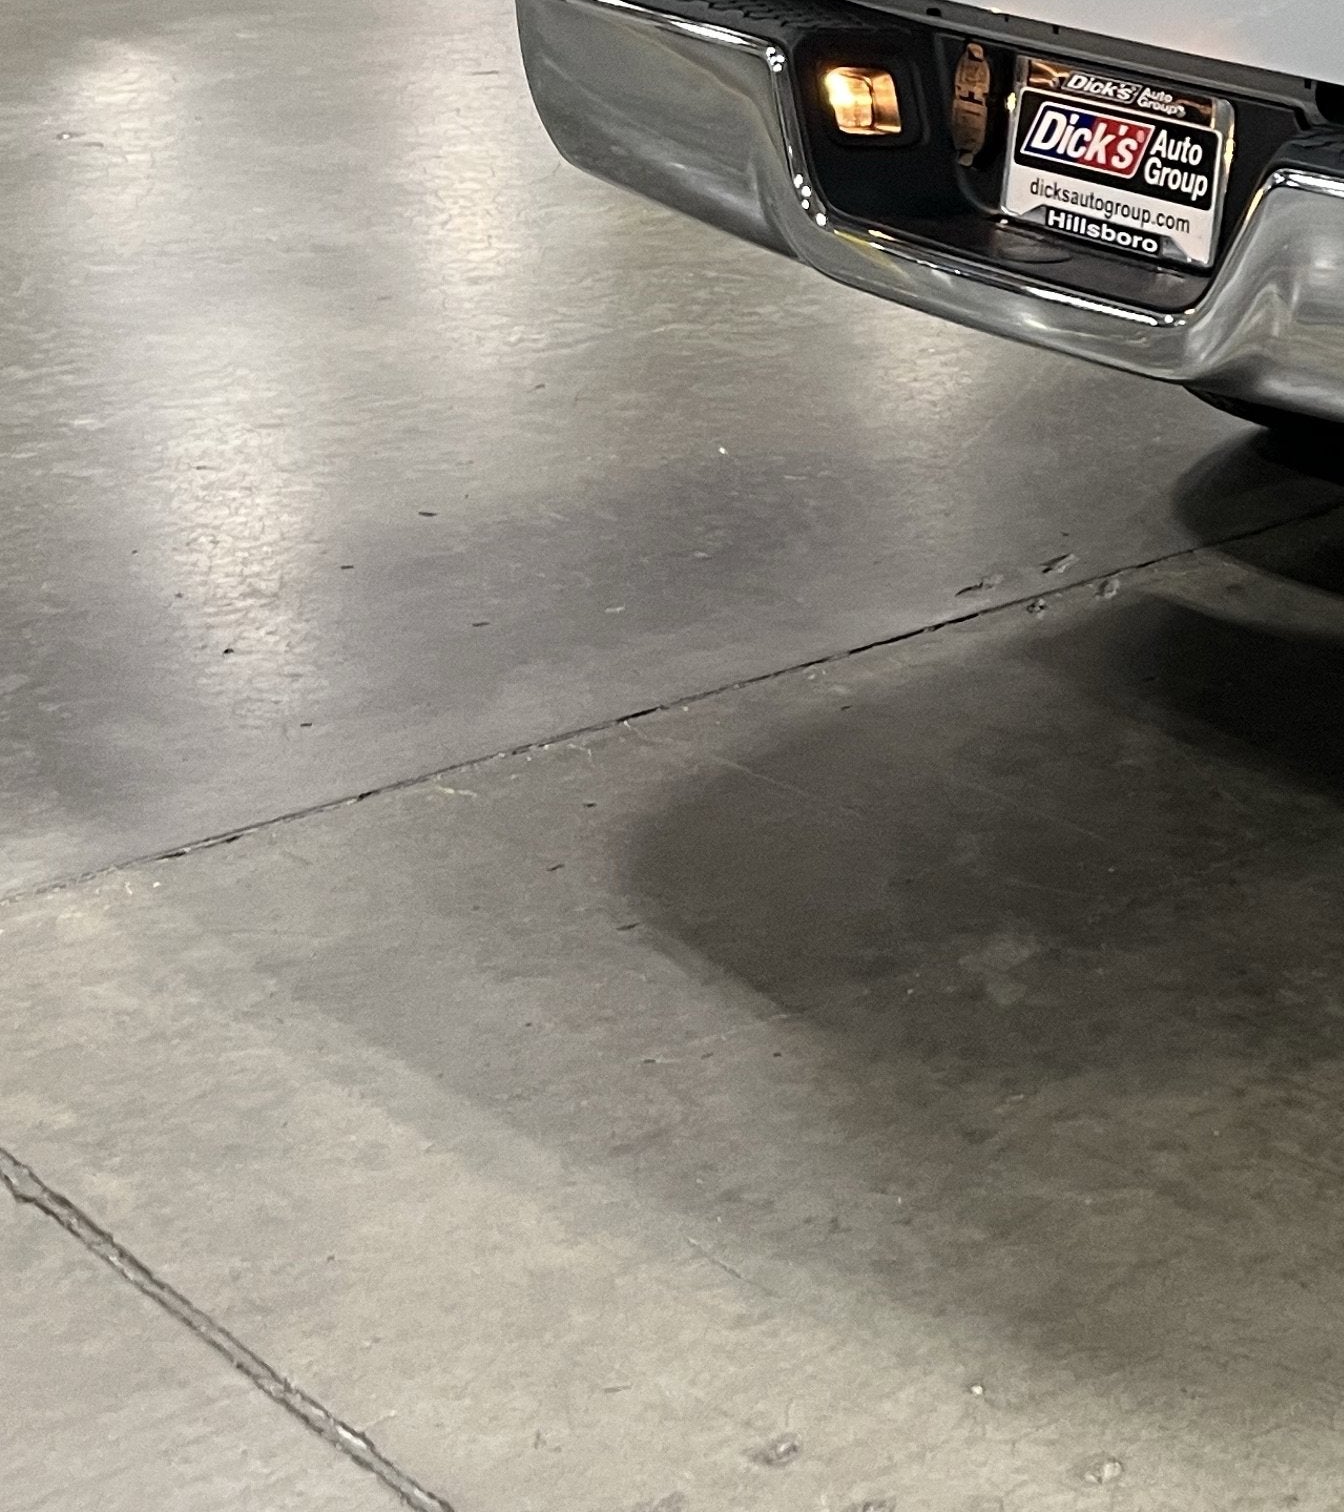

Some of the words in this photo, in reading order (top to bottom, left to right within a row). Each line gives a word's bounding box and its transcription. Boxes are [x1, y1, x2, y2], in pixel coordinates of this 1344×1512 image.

[1067, 74, 1133, 101] Dick's
[1137, 97, 1179, 116] Group
[1140, 87, 1173, 103] Auto
[1030, 110, 1139, 170] Dick's
[1150, 129, 1203, 166] Auto
[1144, 157, 1208, 201] Group
[1030, 177, 1191, 234] dicksautogroup.com
[1047, 209, 1159, 254] Hillsboro
